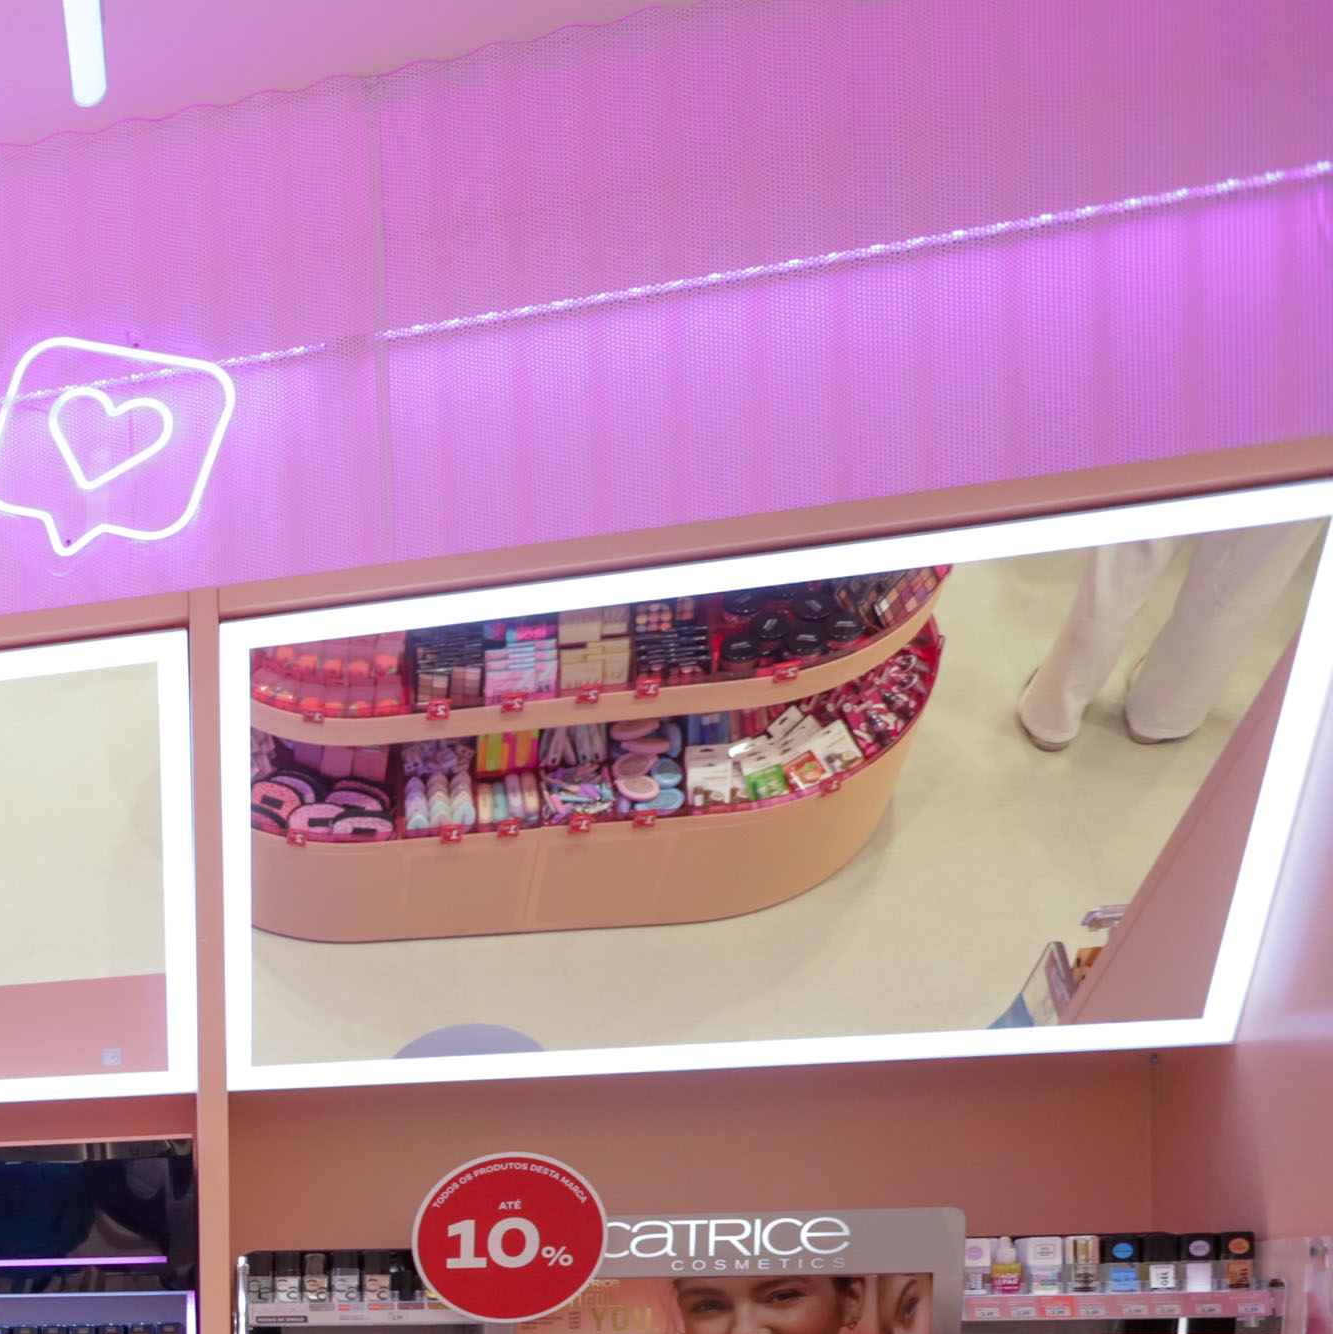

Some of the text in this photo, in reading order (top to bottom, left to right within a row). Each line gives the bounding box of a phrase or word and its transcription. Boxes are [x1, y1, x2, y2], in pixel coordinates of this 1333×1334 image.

[433, 1162, 587, 1209] TODOS OS PRODUTOS DESTA MARCA
[498, 1199, 522, 1210] ATÉ
[446, 1217, 574, 1269] 10%
[671, 1257, 846, 1271] COSMETICS
